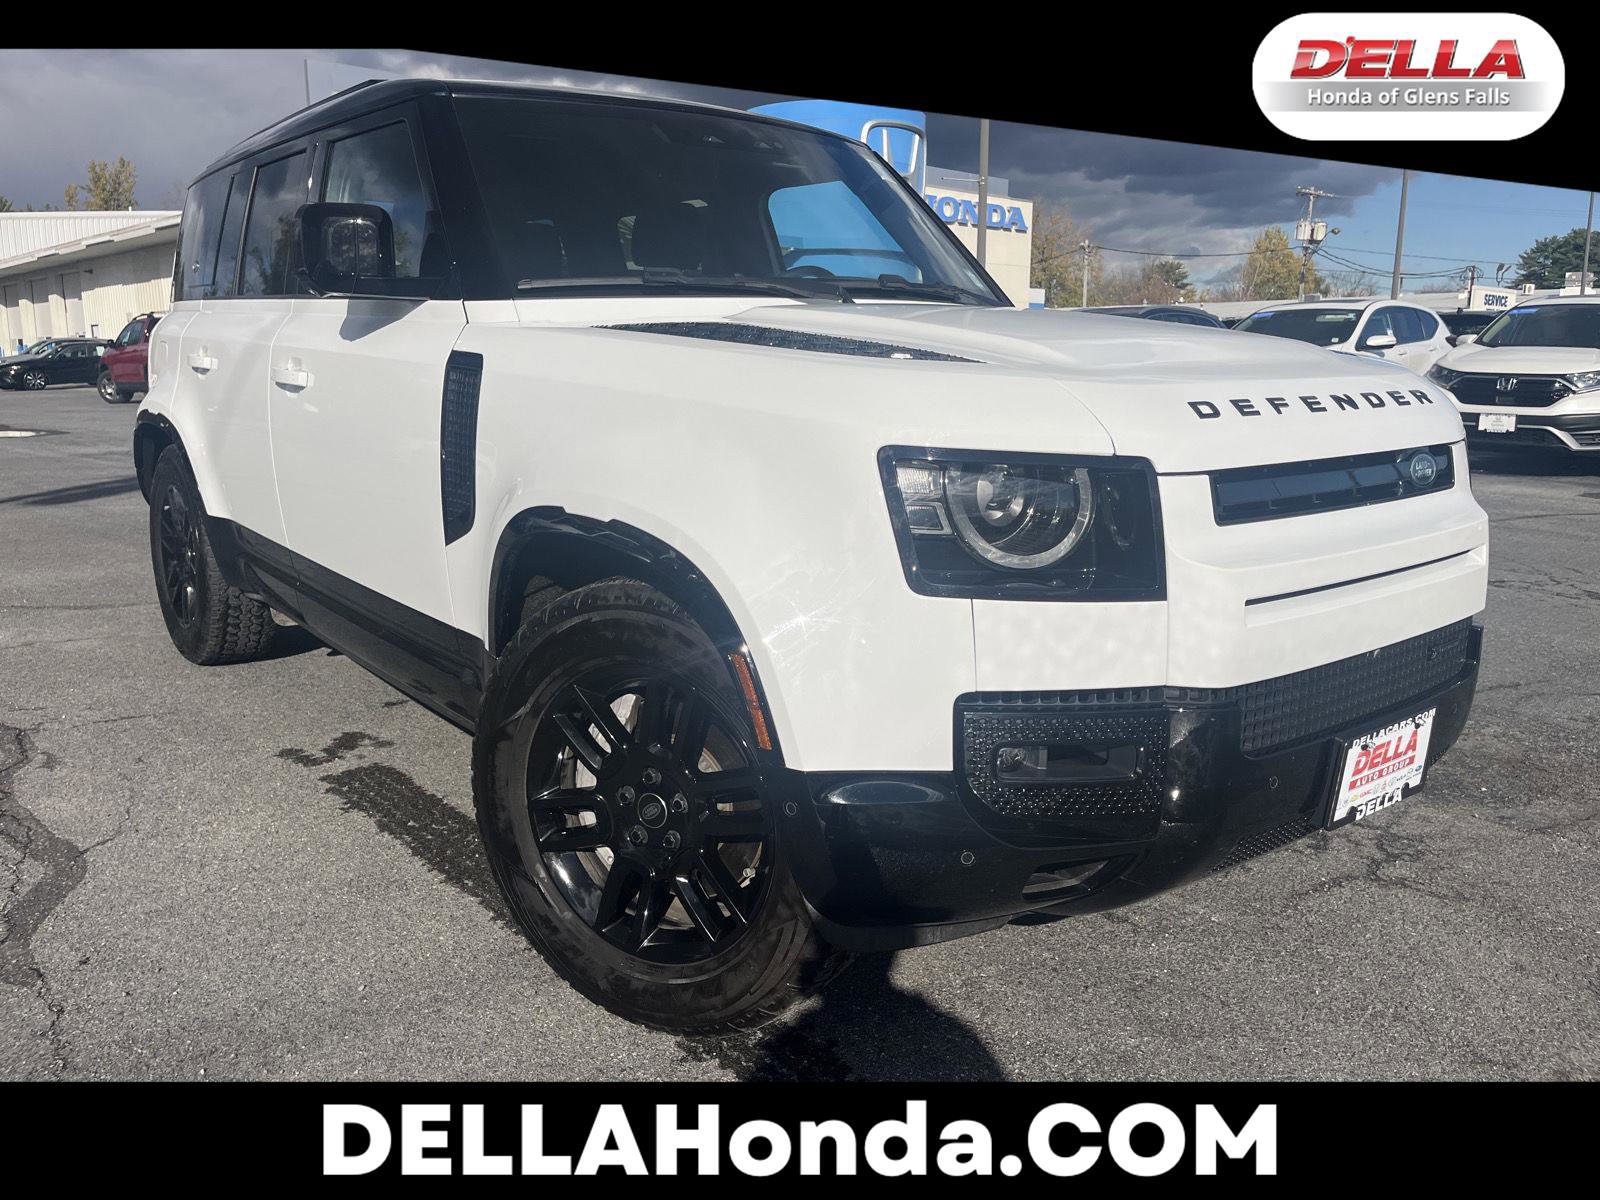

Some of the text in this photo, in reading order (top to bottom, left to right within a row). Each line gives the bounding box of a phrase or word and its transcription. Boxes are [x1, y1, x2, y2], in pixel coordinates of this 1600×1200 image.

[1483, 293, 1509, 308] SERVICE
[1187, 389, 1434, 420] DEFENDER
[1351, 729, 1418, 777] DELLA
[1355, 770, 1379, 788] AUTO
[1382, 758, 1411, 776] GROUP
[1355, 787, 1402, 821] DELLA
